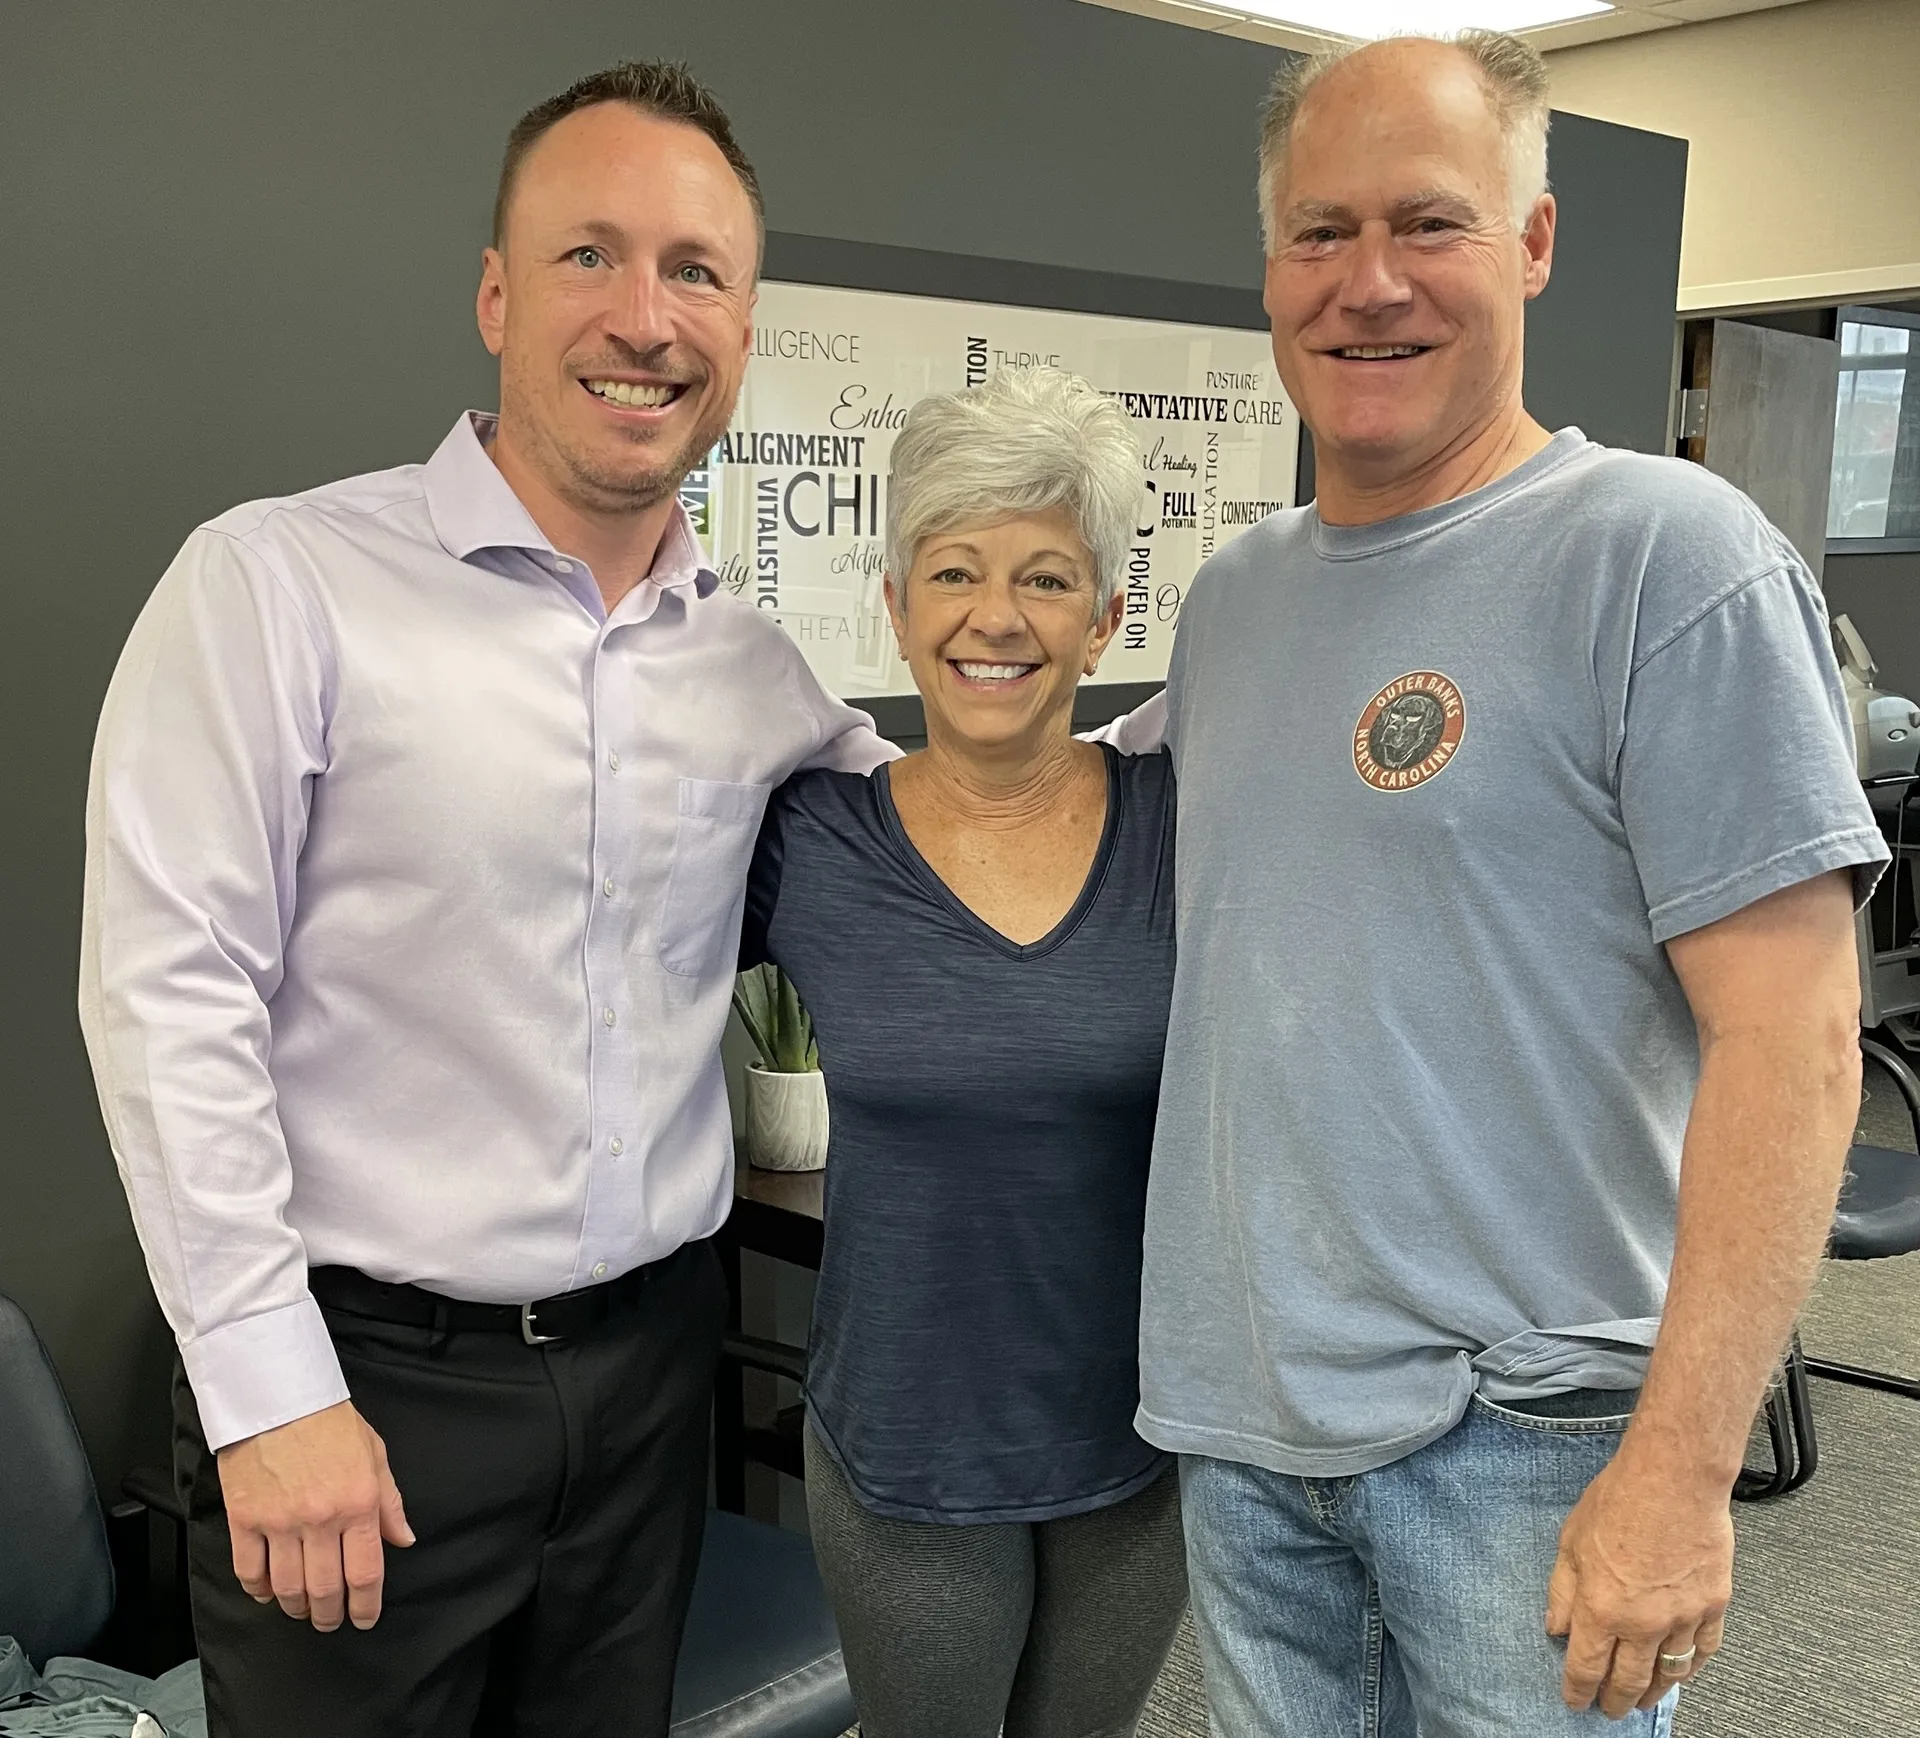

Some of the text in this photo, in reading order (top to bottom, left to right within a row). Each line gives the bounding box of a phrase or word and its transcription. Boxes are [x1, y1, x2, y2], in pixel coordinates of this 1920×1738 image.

[750, 327, 860, 363] LLIGENCE
[1205, 371, 1260, 391] POSTURE
[1233, 399, 1283, 425] CARE
[716, 430, 865, 467] ALIGNMENT
[1163, 491, 1197, 516] FULL
[1161, 517, 1197, 529] POTENTIAL
[757, 477, 779, 609] VITALISTIC
[716, 553, 753, 596] ily
[1126, 547, 1151, 615] POWER
[1124, 623, 1147, 649] ON
[1376, 675, 1460, 718] OUTER BANKS
[1356, 728, 1456, 787] NORTH CAROLINA
